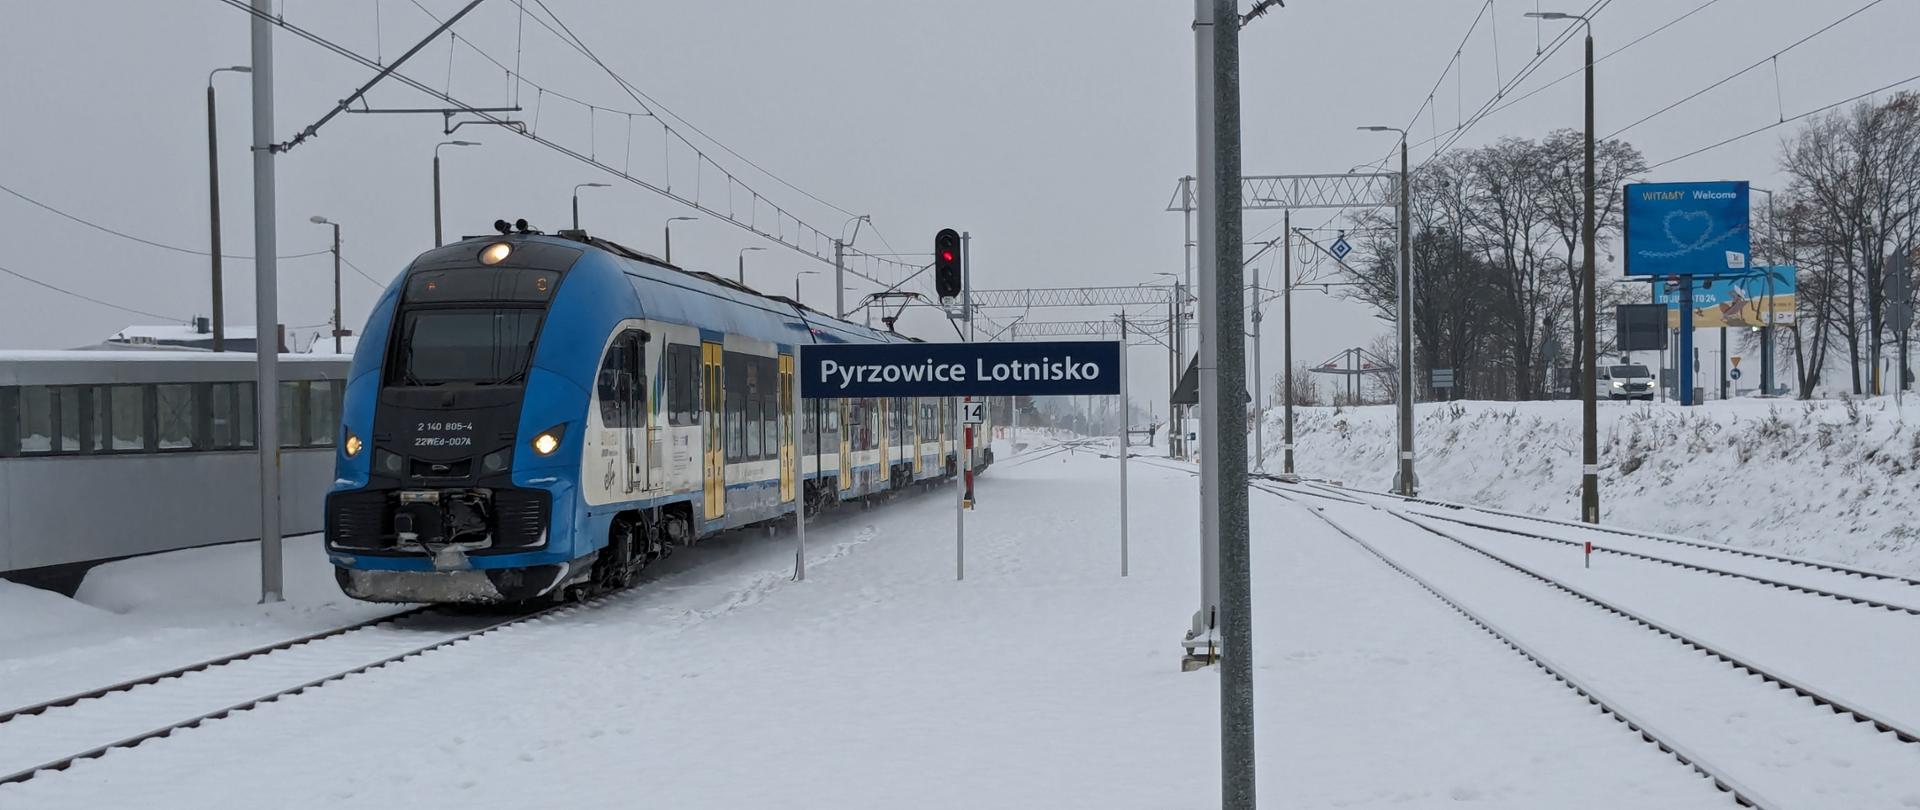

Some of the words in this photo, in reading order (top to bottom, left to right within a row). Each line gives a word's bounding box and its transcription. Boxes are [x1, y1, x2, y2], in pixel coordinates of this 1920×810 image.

[1692, 190, 1737, 200] Welcome
[821, 358, 966, 389] Pyrzowice
[976, 355, 1100, 381] Lotnisko
[964, 404, 981, 421] 14
[417, 422, 425, 431] 2
[427, 422, 442, 431] 140
[445, 422, 473, 431] 805-4
